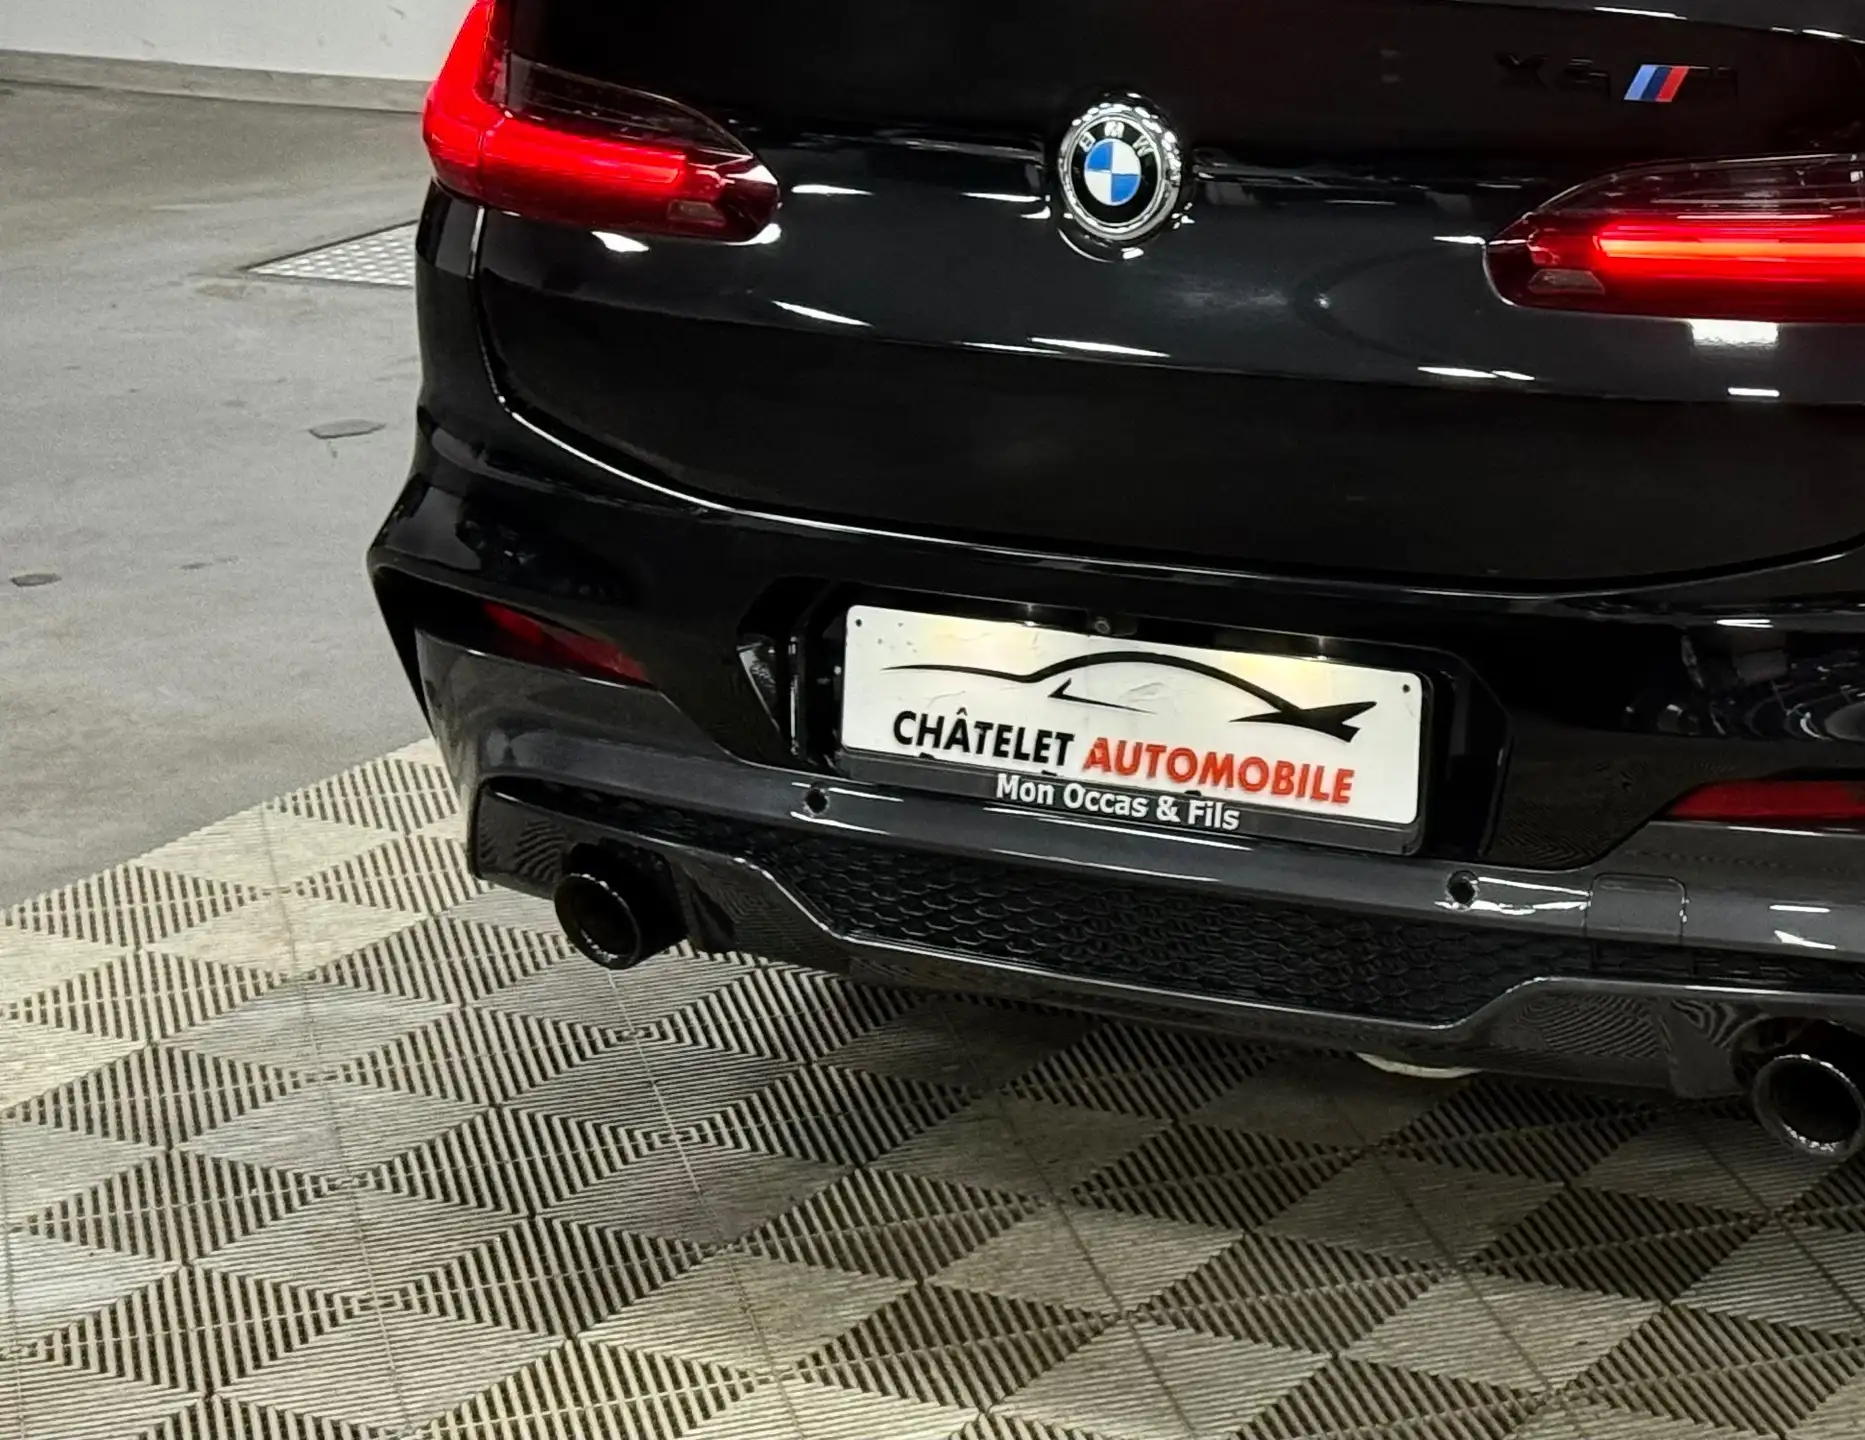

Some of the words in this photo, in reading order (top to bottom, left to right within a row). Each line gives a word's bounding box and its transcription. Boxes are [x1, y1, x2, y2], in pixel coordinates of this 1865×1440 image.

[1079, 121, 1155, 157] BMW
[893, 707, 1076, 767] CHÂTELET
[1083, 737, 1355, 804] AUTOMOBILE
[996, 773, 1054, 806] Mon
[1062, 784, 1148, 820] Occas
[1156, 798, 1180, 823] &
[1187, 800, 1240, 831] Fils
